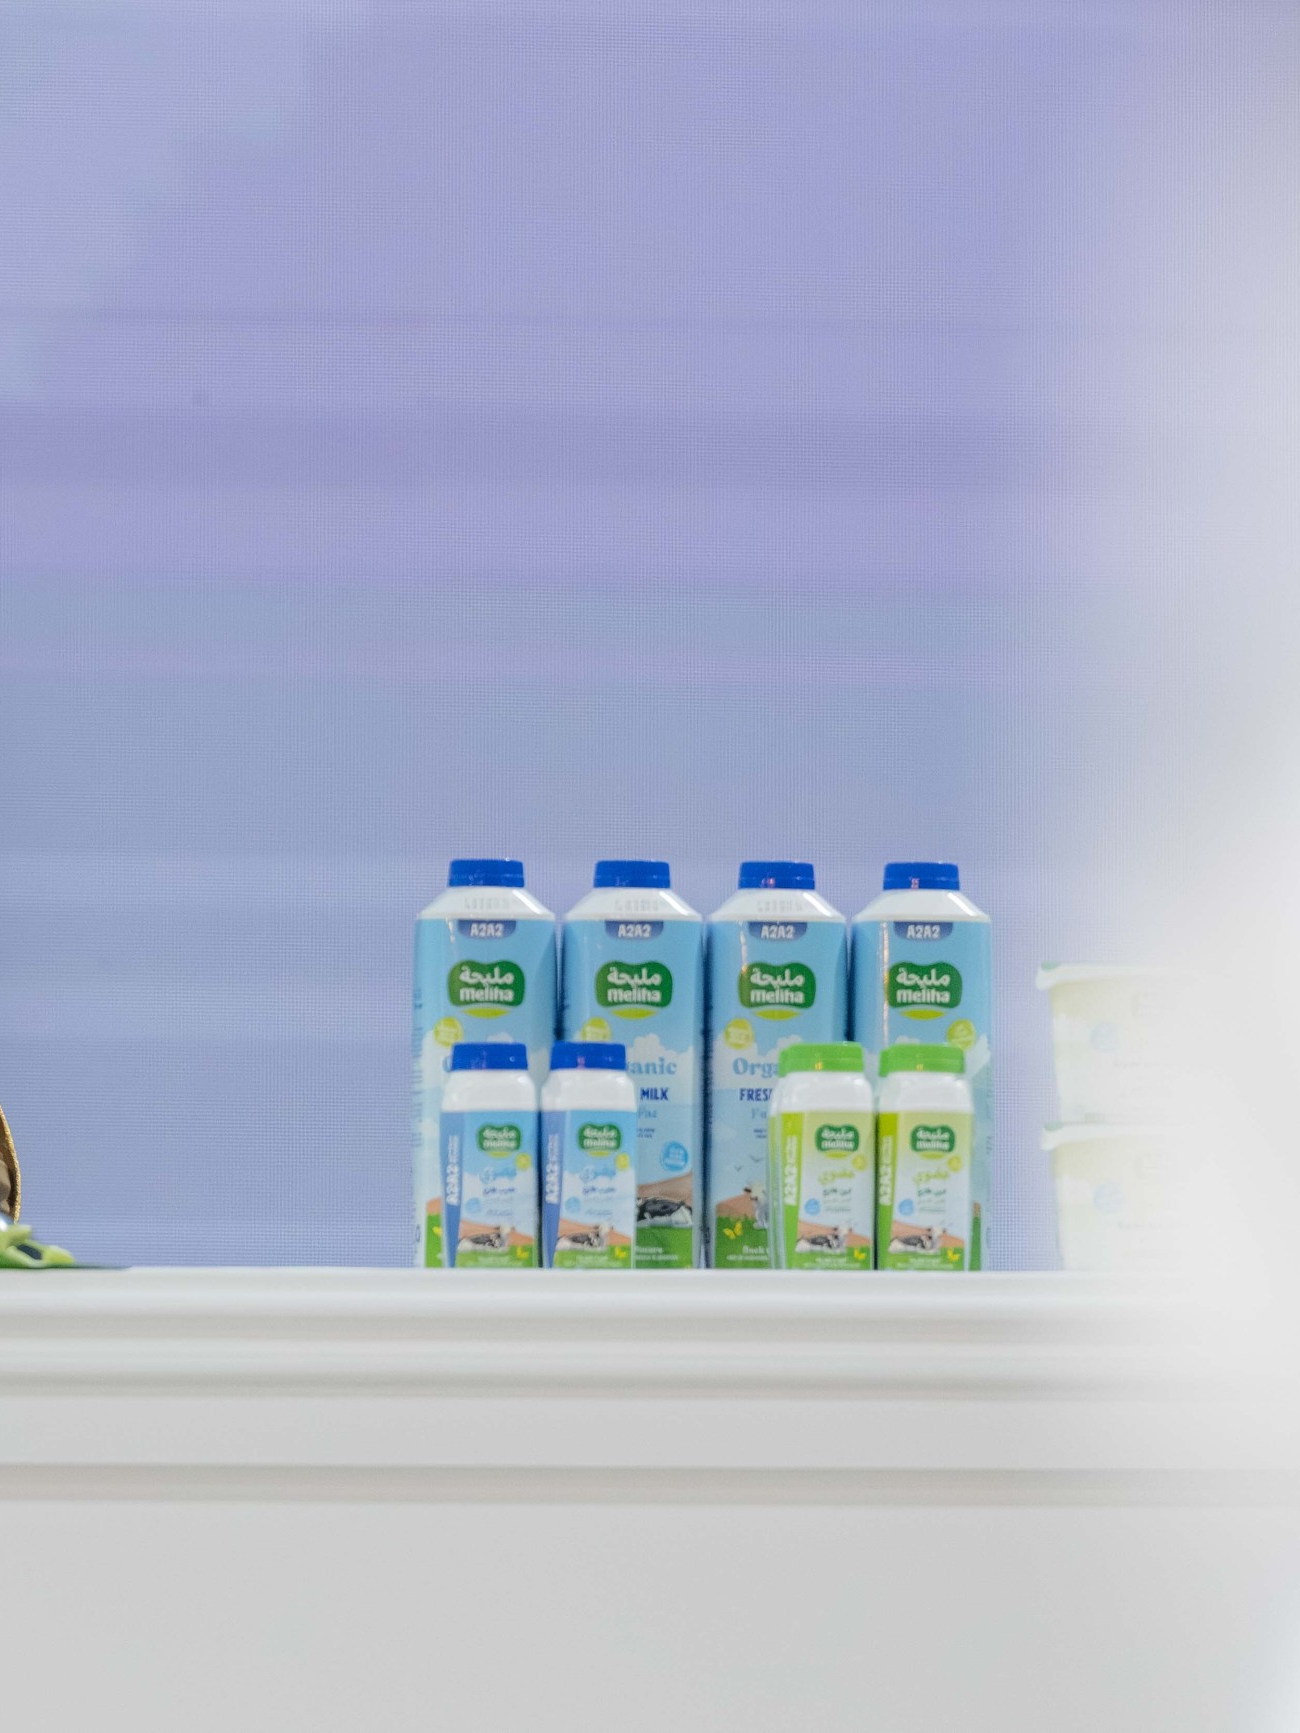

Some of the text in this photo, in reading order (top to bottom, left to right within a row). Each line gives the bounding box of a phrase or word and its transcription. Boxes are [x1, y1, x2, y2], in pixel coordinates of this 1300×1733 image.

[470, 923, 504, 937] A2A2
[618, 924, 651, 937] A2A2
[761, 925, 795, 939] A2A2
[906, 925, 940, 939] A2A2
[459, 965, 514, 986] مليحة
[607, 966, 662, 987] مليحة
[750, 968, 804, 988] مليحة
[896, 967, 950, 988] مليحة
[460, 986, 514, 1002] meliha
[607, 988, 661, 1003] meliha
[750, 989, 804, 1004] meliha
[896, 988, 950, 1004] meliha
[628, 1057, 677, 1075] anic
[640, 1087, 668, 1101] MILK
[740, 1088, 772, 1101] FRES
[446, 1164, 459, 1205] A2A2
[546, 1163, 558, 1204] A2A2
[784, 1167, 796, 1205] A2A2
[879, 1167, 891, 1205] A2A2
